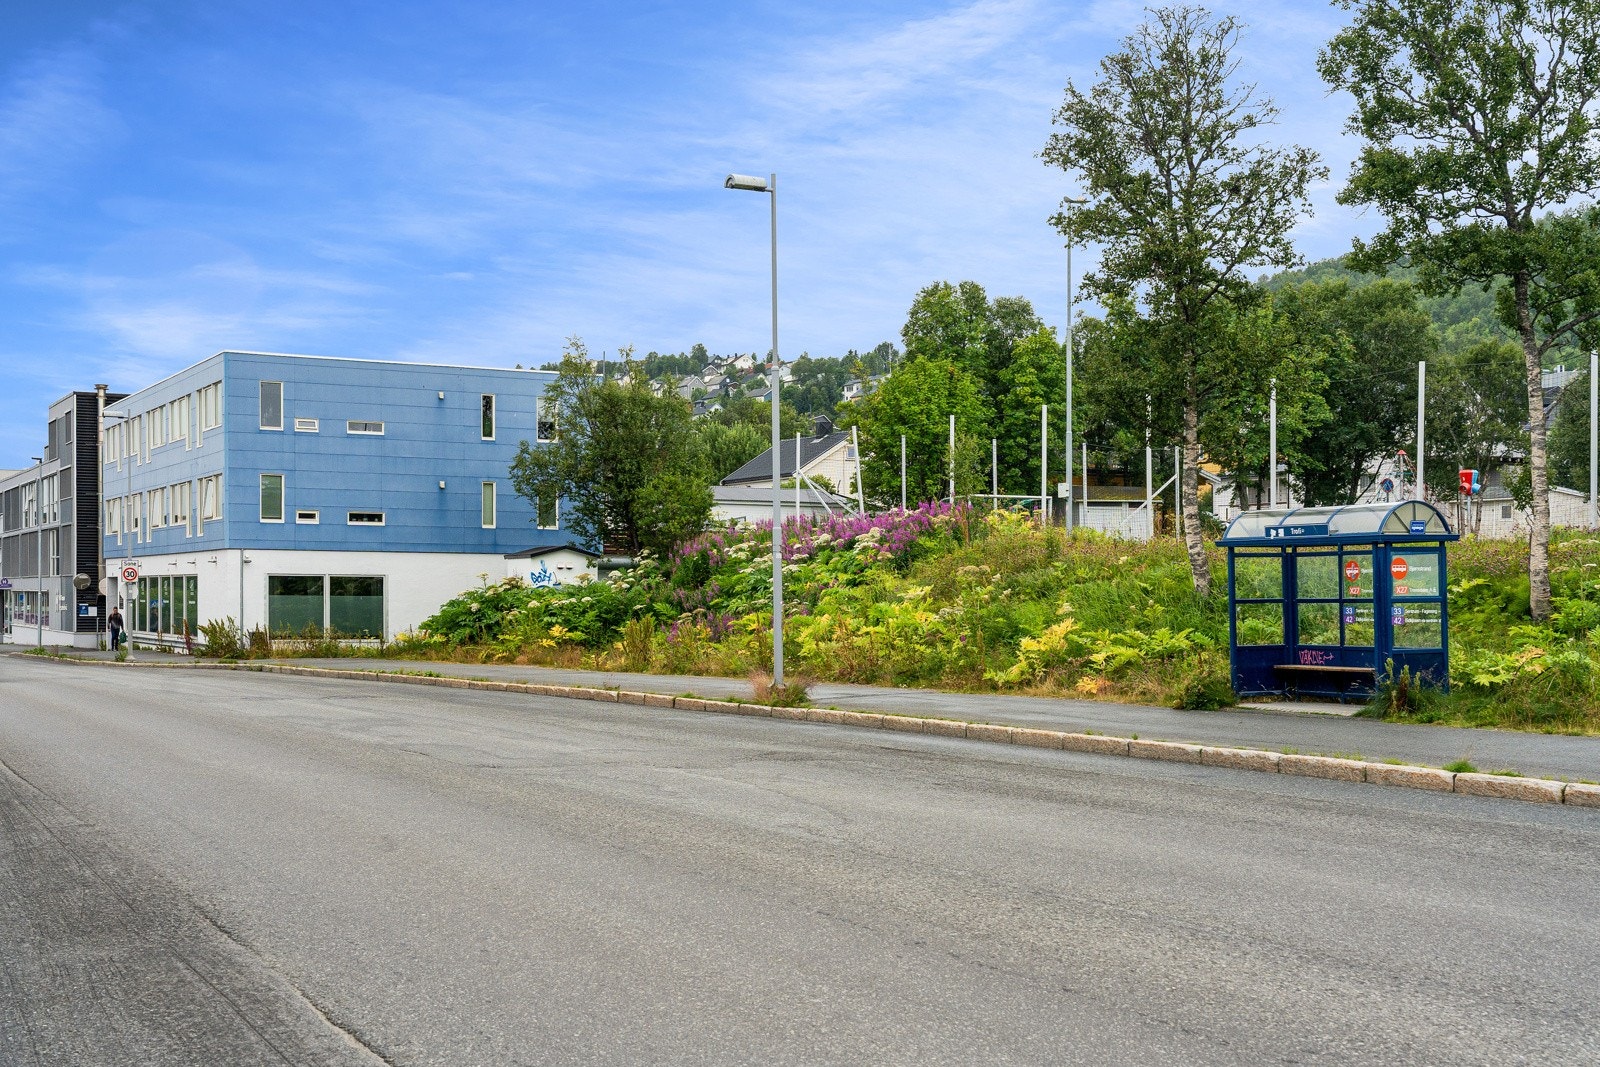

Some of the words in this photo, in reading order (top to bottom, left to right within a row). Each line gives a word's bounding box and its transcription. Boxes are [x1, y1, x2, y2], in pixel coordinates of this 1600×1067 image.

[126, 570, 135, 578] 30
[1396, 586, 1408, 594] X27
[1393, 607, 1402, 615] 33
